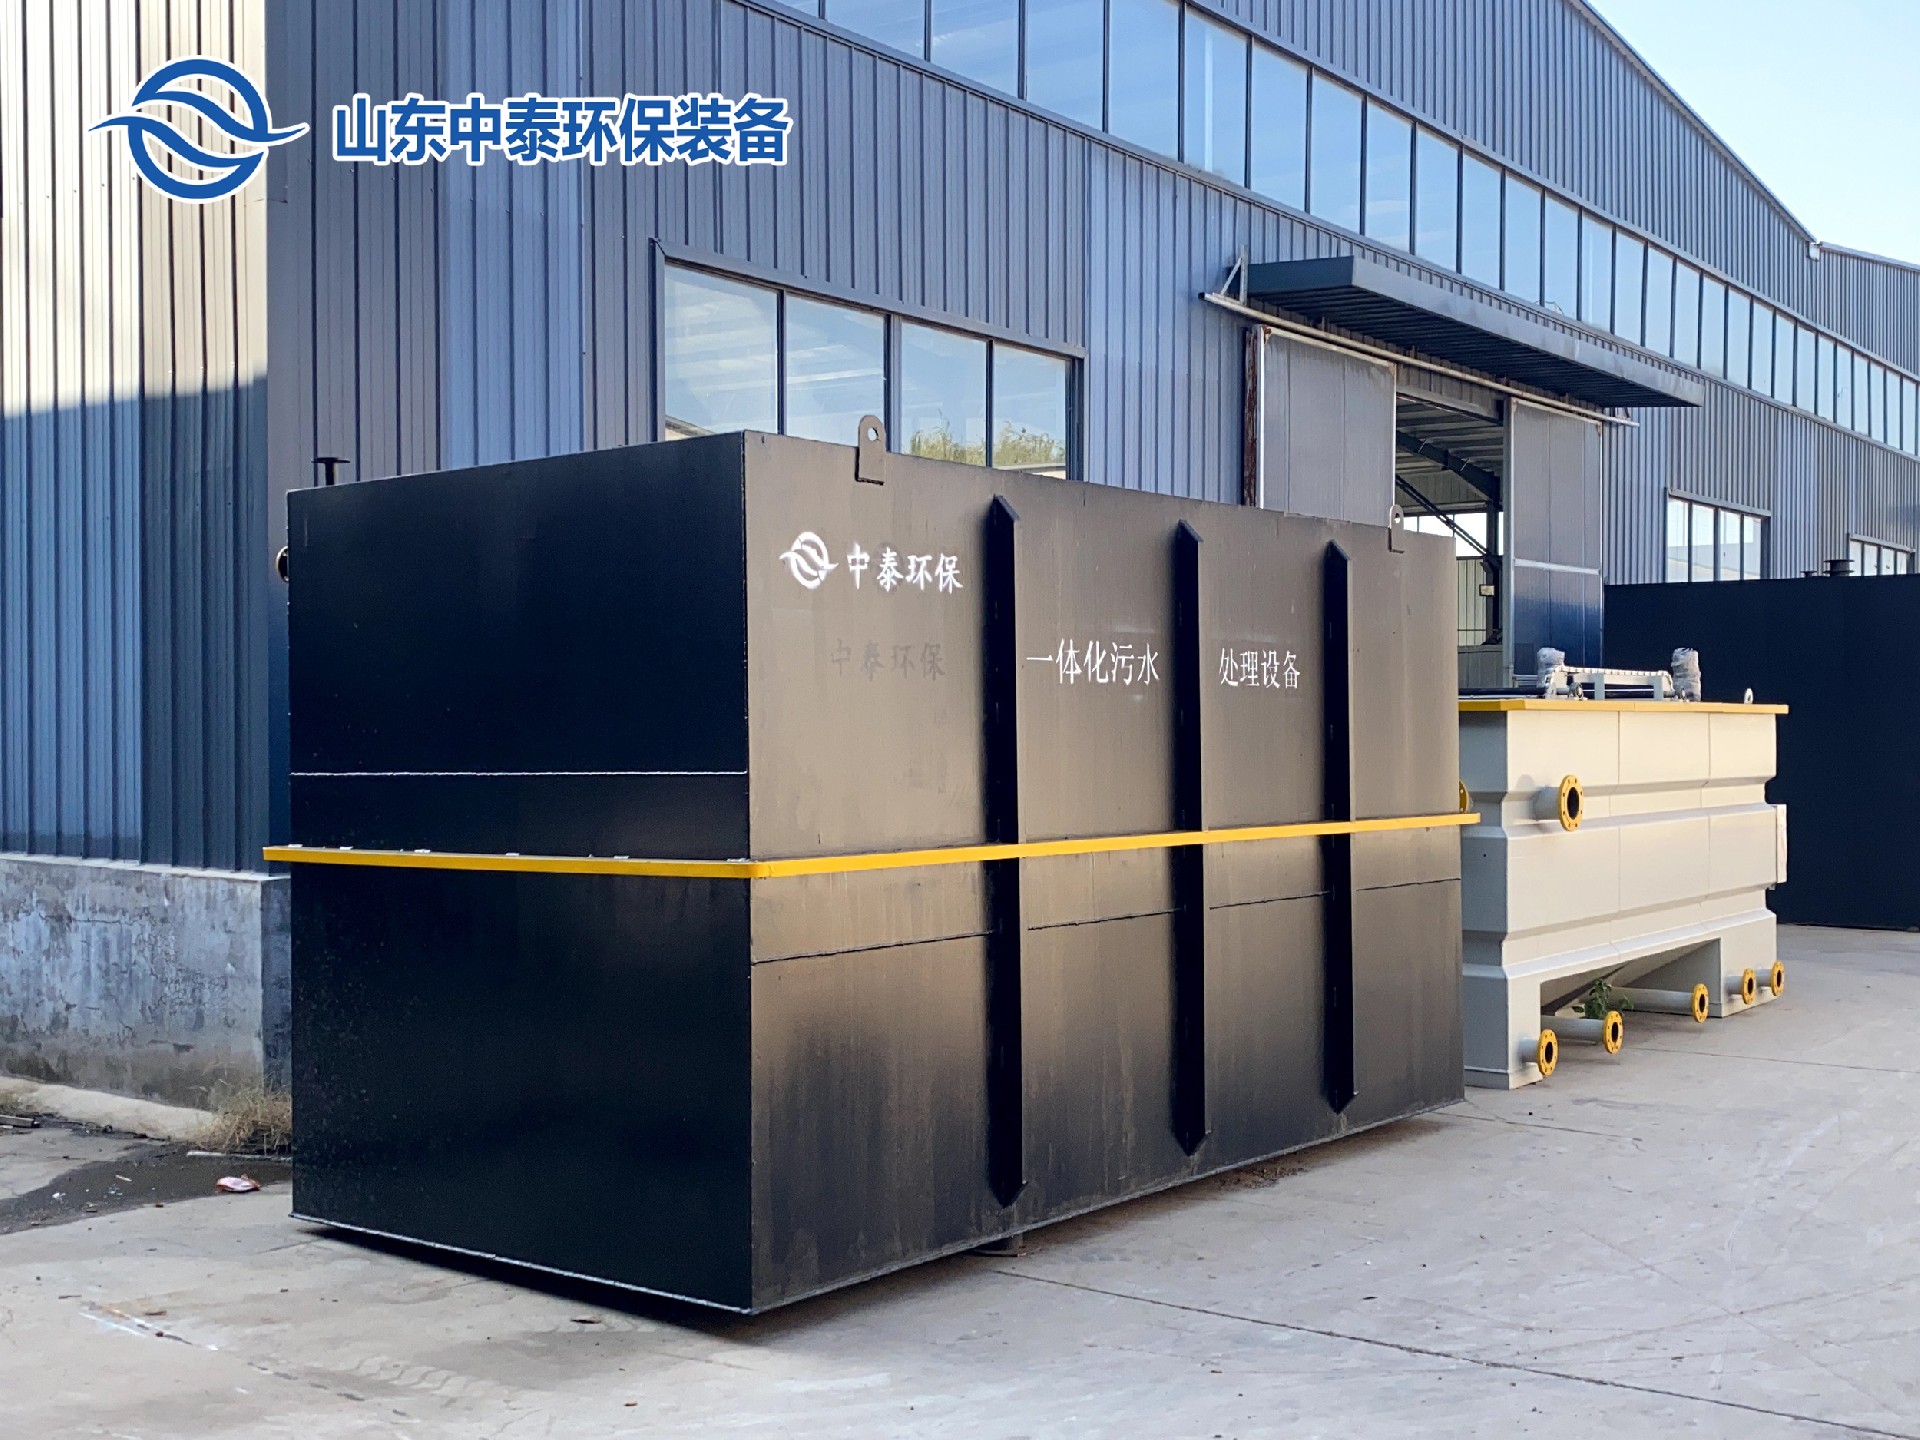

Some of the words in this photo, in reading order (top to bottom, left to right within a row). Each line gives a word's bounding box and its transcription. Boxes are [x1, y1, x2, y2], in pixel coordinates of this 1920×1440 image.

[847, 542, 963, 594] 中泰环保
[1026, 638, 1160, 686] 一体化污水
[1219, 648, 1301, 689] 处理设备
